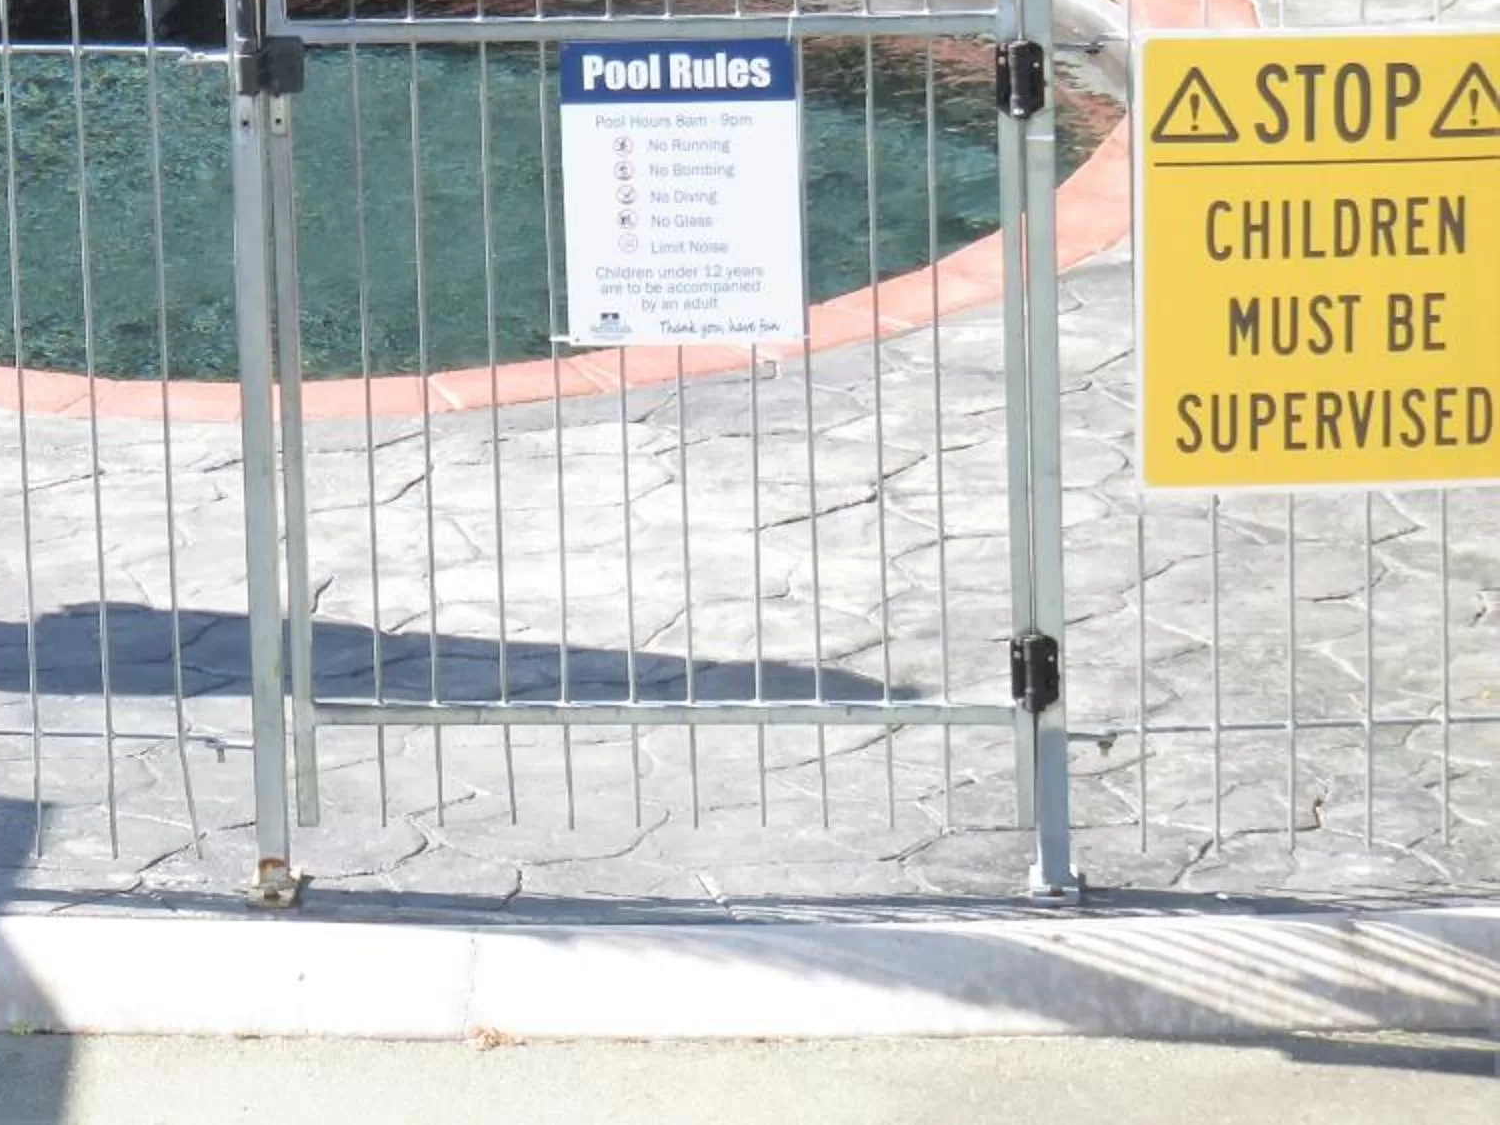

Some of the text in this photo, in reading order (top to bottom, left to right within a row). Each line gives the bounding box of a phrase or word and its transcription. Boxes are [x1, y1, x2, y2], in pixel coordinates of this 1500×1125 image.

[582, 52, 771, 90] Pool Rules
[1254, 61, 1423, 145] STOP
[595, 115, 625, 128] Pool
[630, 115, 672, 128] Hours
[675, 114, 707, 128] 8am
[720, 113, 752, 127] 9pm
[649, 138, 731, 154] No Running
[650, 163, 735, 178] No Bombing
[650, 190, 717, 205] No Diving
[651, 215, 713, 227] No Glass
[1205, 195, 1467, 262] CHILDREN
[652, 241, 728, 254] Limit Noise
[596, 264, 764, 281] Children under 12 years
[601, 279, 761, 296] are to be accompanied
[642, 297, 717, 312] by an adult
[661, 321, 697, 334] Thank
[728, 318, 756, 332] have
[759, 320, 780, 335] fun
[1228, 293, 1447, 356] MUST BE
[1176, 386, 1492, 453] SUPERVISED
